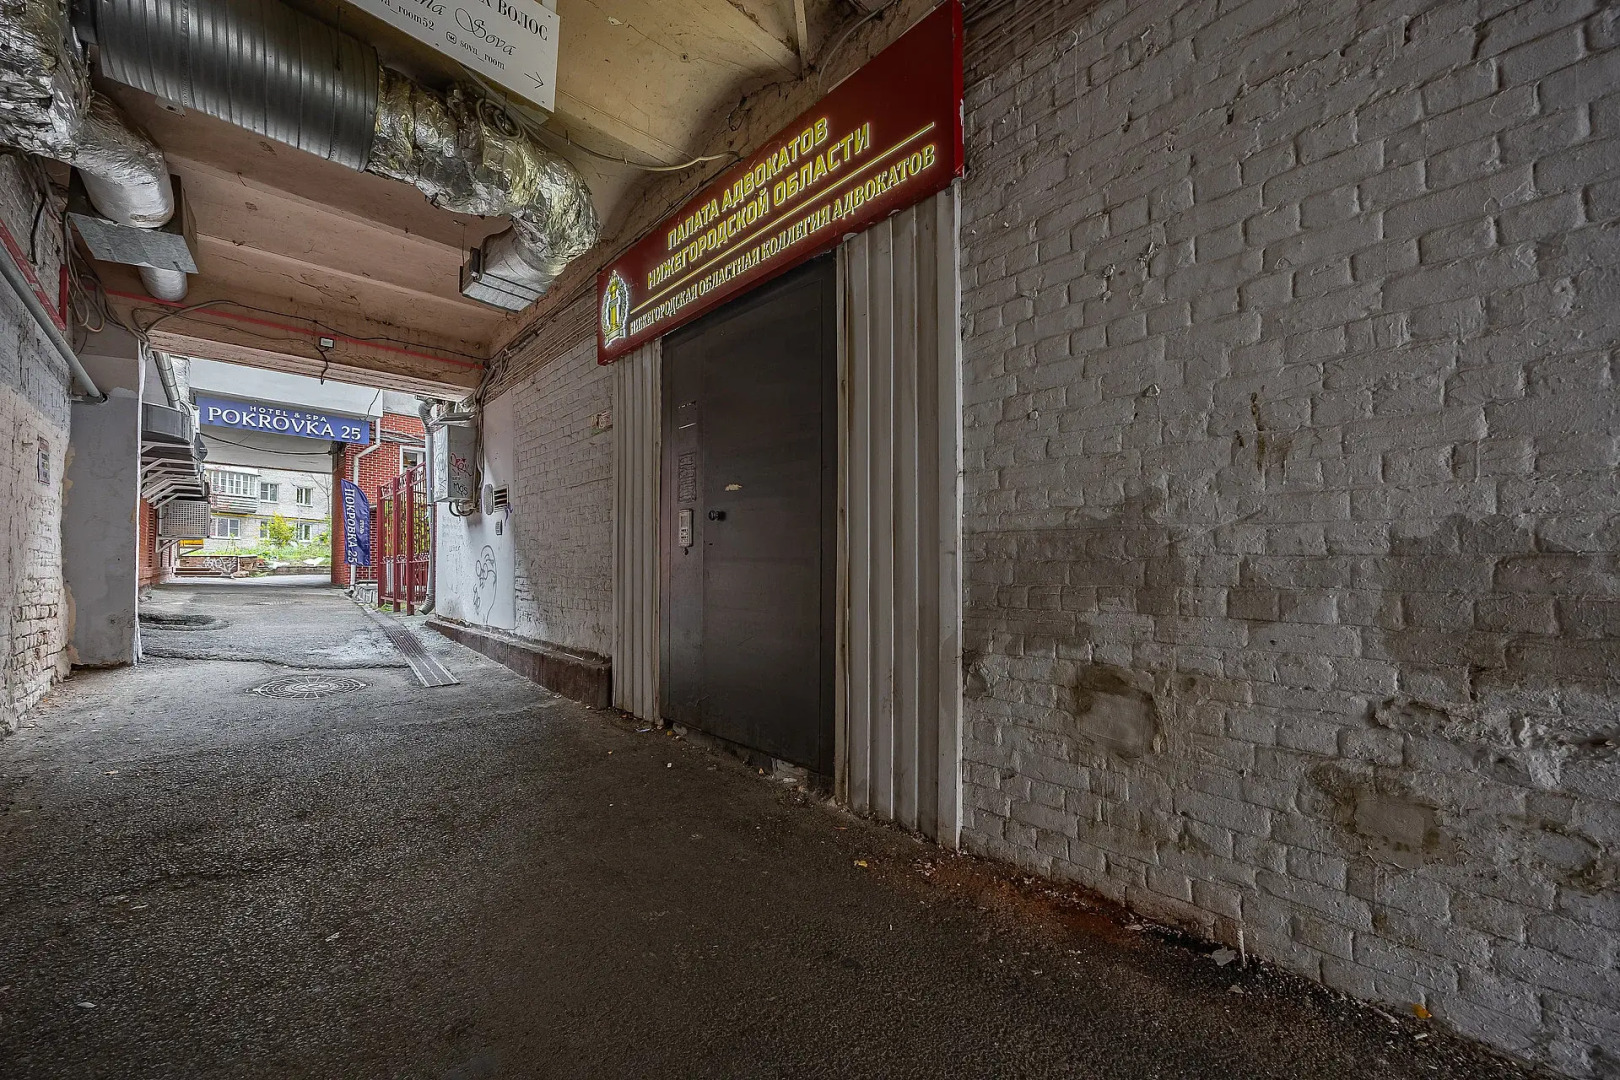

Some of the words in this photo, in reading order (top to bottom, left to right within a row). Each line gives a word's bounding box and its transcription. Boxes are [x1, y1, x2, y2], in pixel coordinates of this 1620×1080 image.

[450, 7, 517, 56] Sova
[497, 0, 548, 41] ВОЛОС
[459, 40, 505, 70] sova_room
[647, 187, 769, 290] НИЖЕГОРОДСКОЙ
[773, 122, 871, 206] ОБЛАСТИ
[667, 198, 719, 250] ПАЛАТА
[721, 117, 828, 212] АДВОКАТОВ
[629, 282, 698, 336] НИЖЕГОРОДСКАЯ
[699, 246, 761, 296] ОБЛАСТНАЯ
[760, 204, 832, 261] КОЛЛЕГИЯ
[831, 144, 936, 221] АДВОКАТОВ
[207, 406, 335, 437] POKROVKA
[341, 425, 361, 441] 25
[250, 405, 288, 417] HOTEL
[306, 413, 327, 423] SPA
[344, 488, 358, 548] ПОКРОВКА
[347, 549, 358, 564] 25
